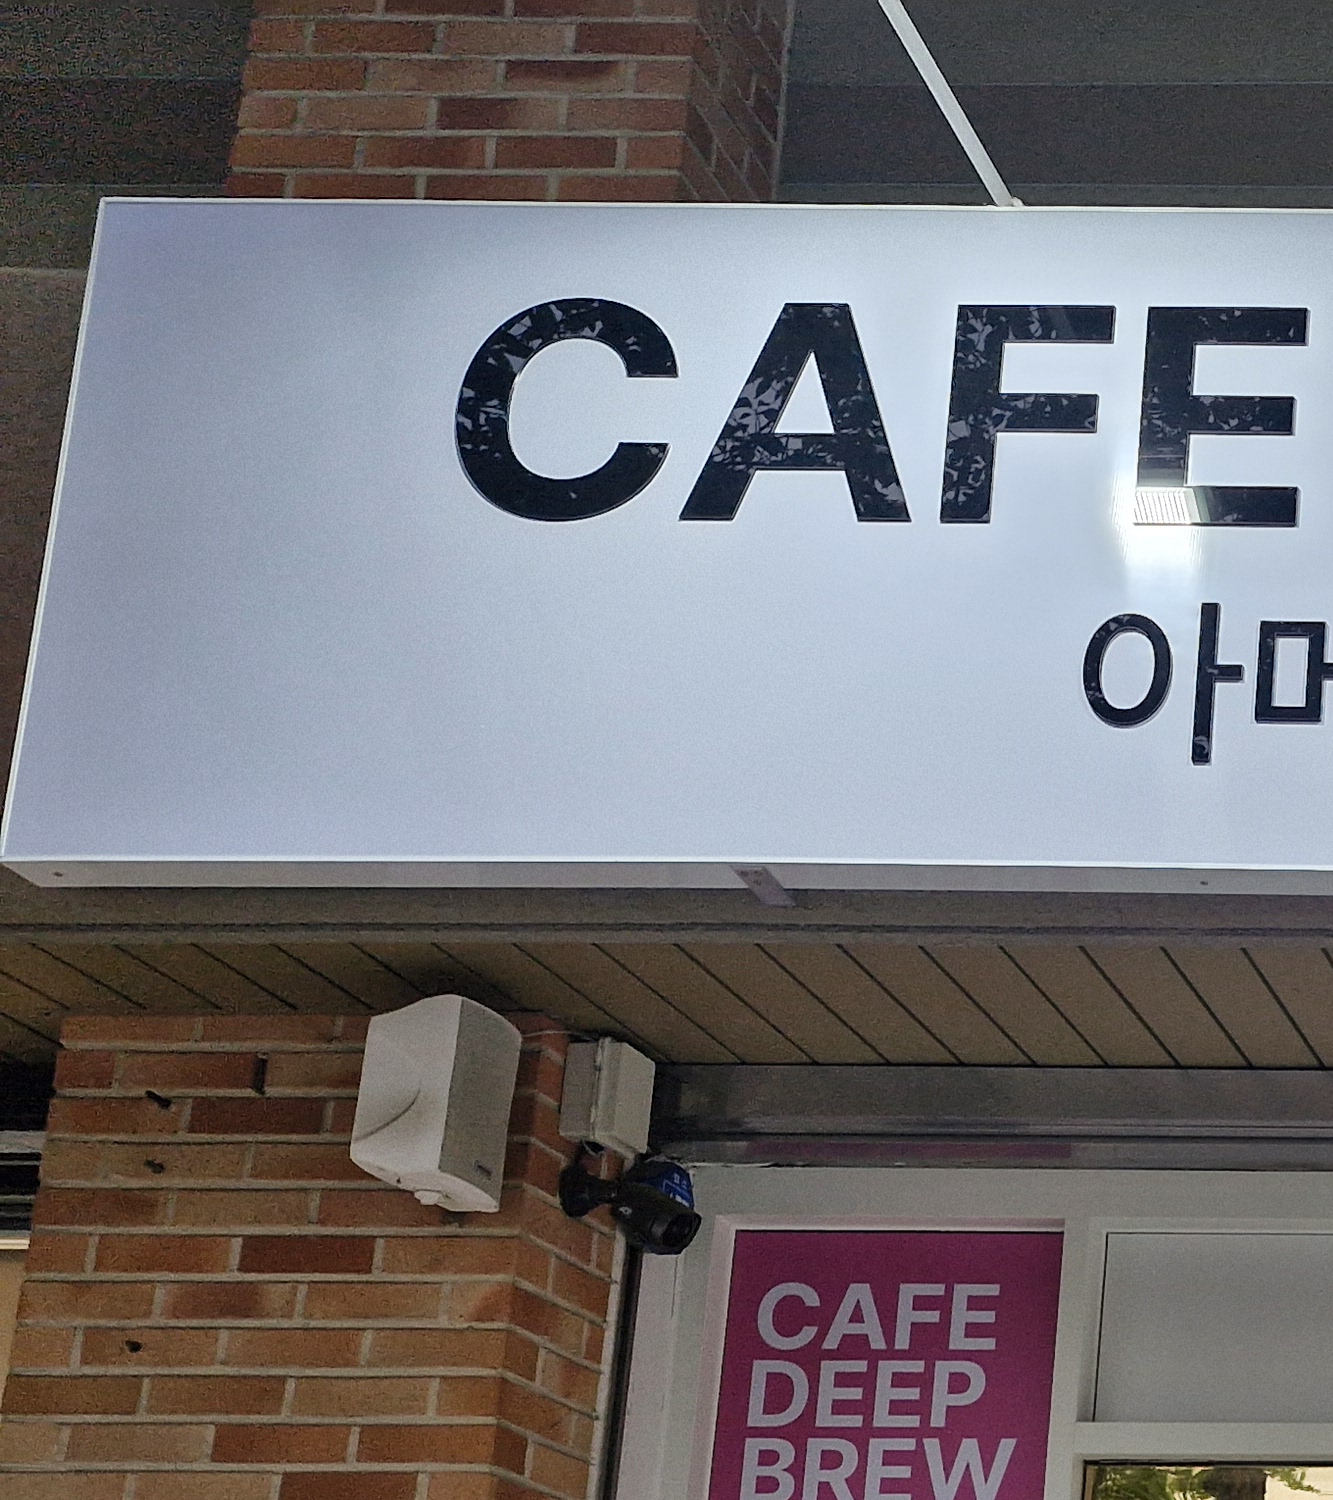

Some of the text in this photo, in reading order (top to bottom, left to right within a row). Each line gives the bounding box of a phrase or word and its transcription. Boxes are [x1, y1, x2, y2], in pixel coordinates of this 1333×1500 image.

[455, 297, 1309, 527] CAFE
[756, 1283, 1000, 1350] CAFE
[747, 1360, 986, 1428] DEEP
